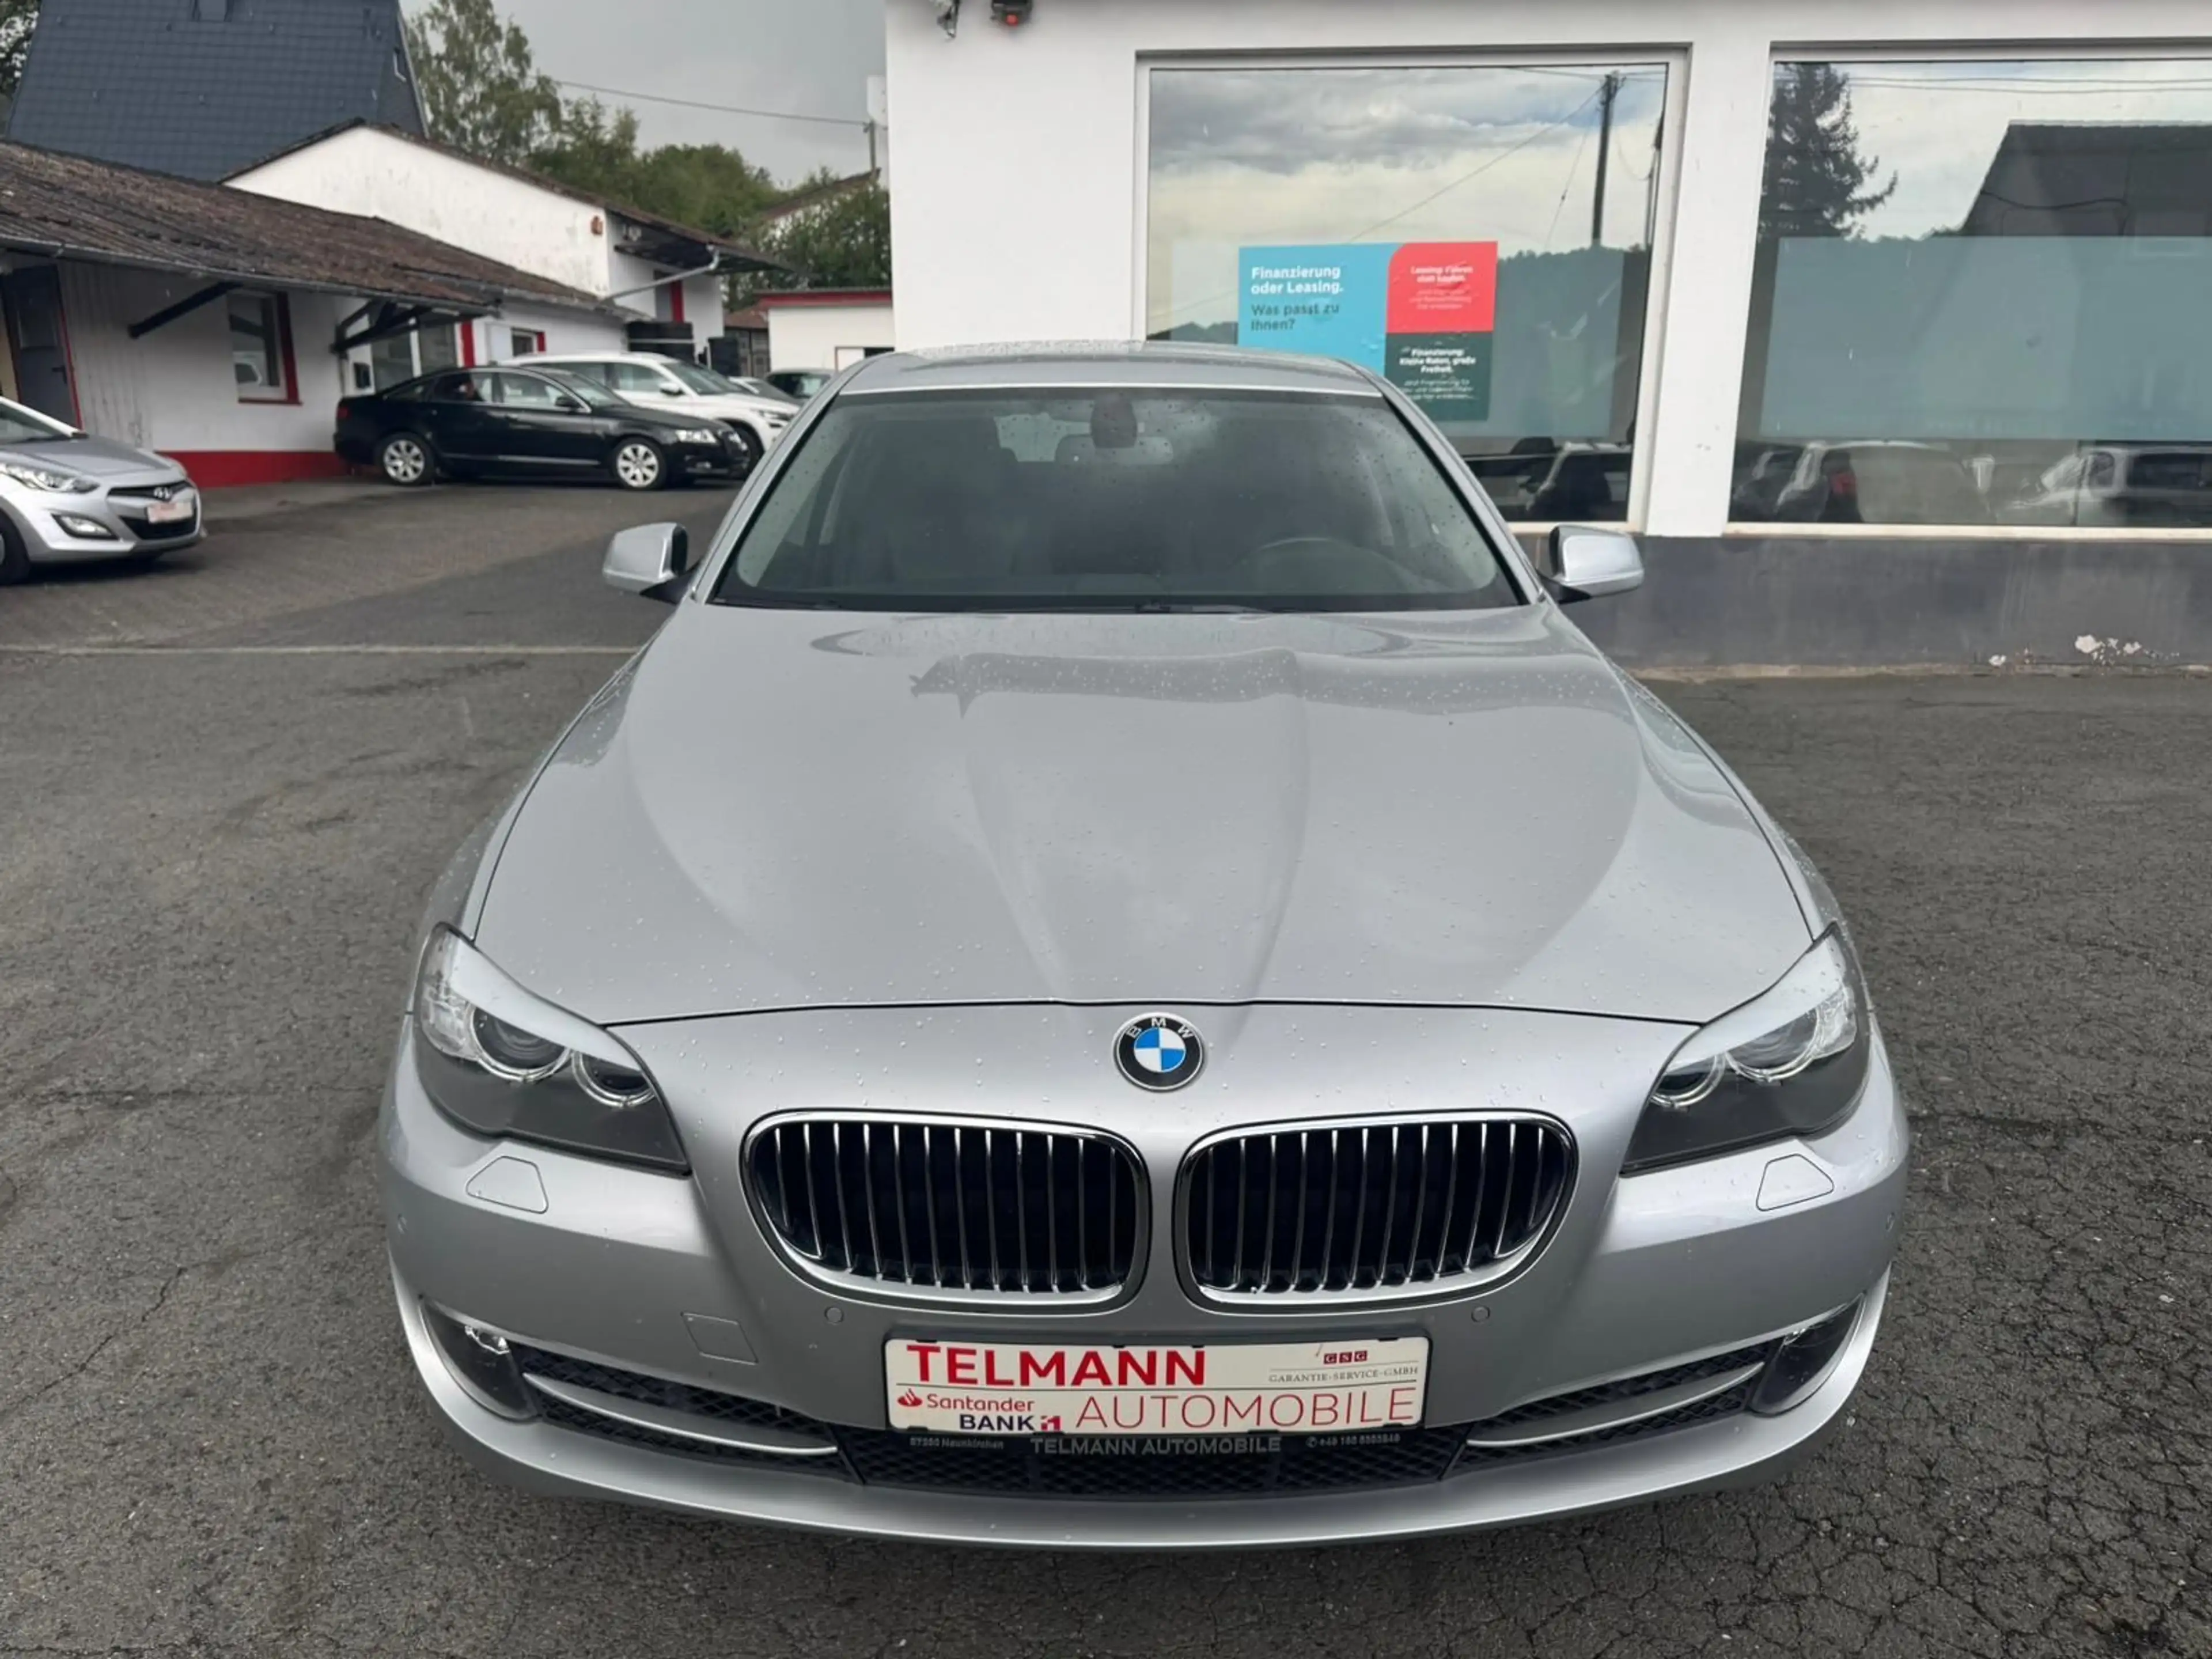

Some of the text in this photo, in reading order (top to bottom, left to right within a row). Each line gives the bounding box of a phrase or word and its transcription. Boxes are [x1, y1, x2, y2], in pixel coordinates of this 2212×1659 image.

[1251, 266, 1340, 279] Finanzierung
[1251, 279, 1344, 294] oder Leasing.
[1251, 302, 1339, 317] Was passt zu
[1251, 318, 1296, 332] Ihnen?
[1126, 1017, 1194, 1039] BMW
[907, 1345, 1205, 1386] TELMANN
[1324, 1350, 1368, 1364] GSG
[927, 1393, 1035, 1411] Santander
[1076, 1388, 1416, 1429] AUTOMOBILE
[959, 1414, 1035, 1431] BANK
[1030, 1437, 1281, 1456] TELMANN AUTOMOBILE
